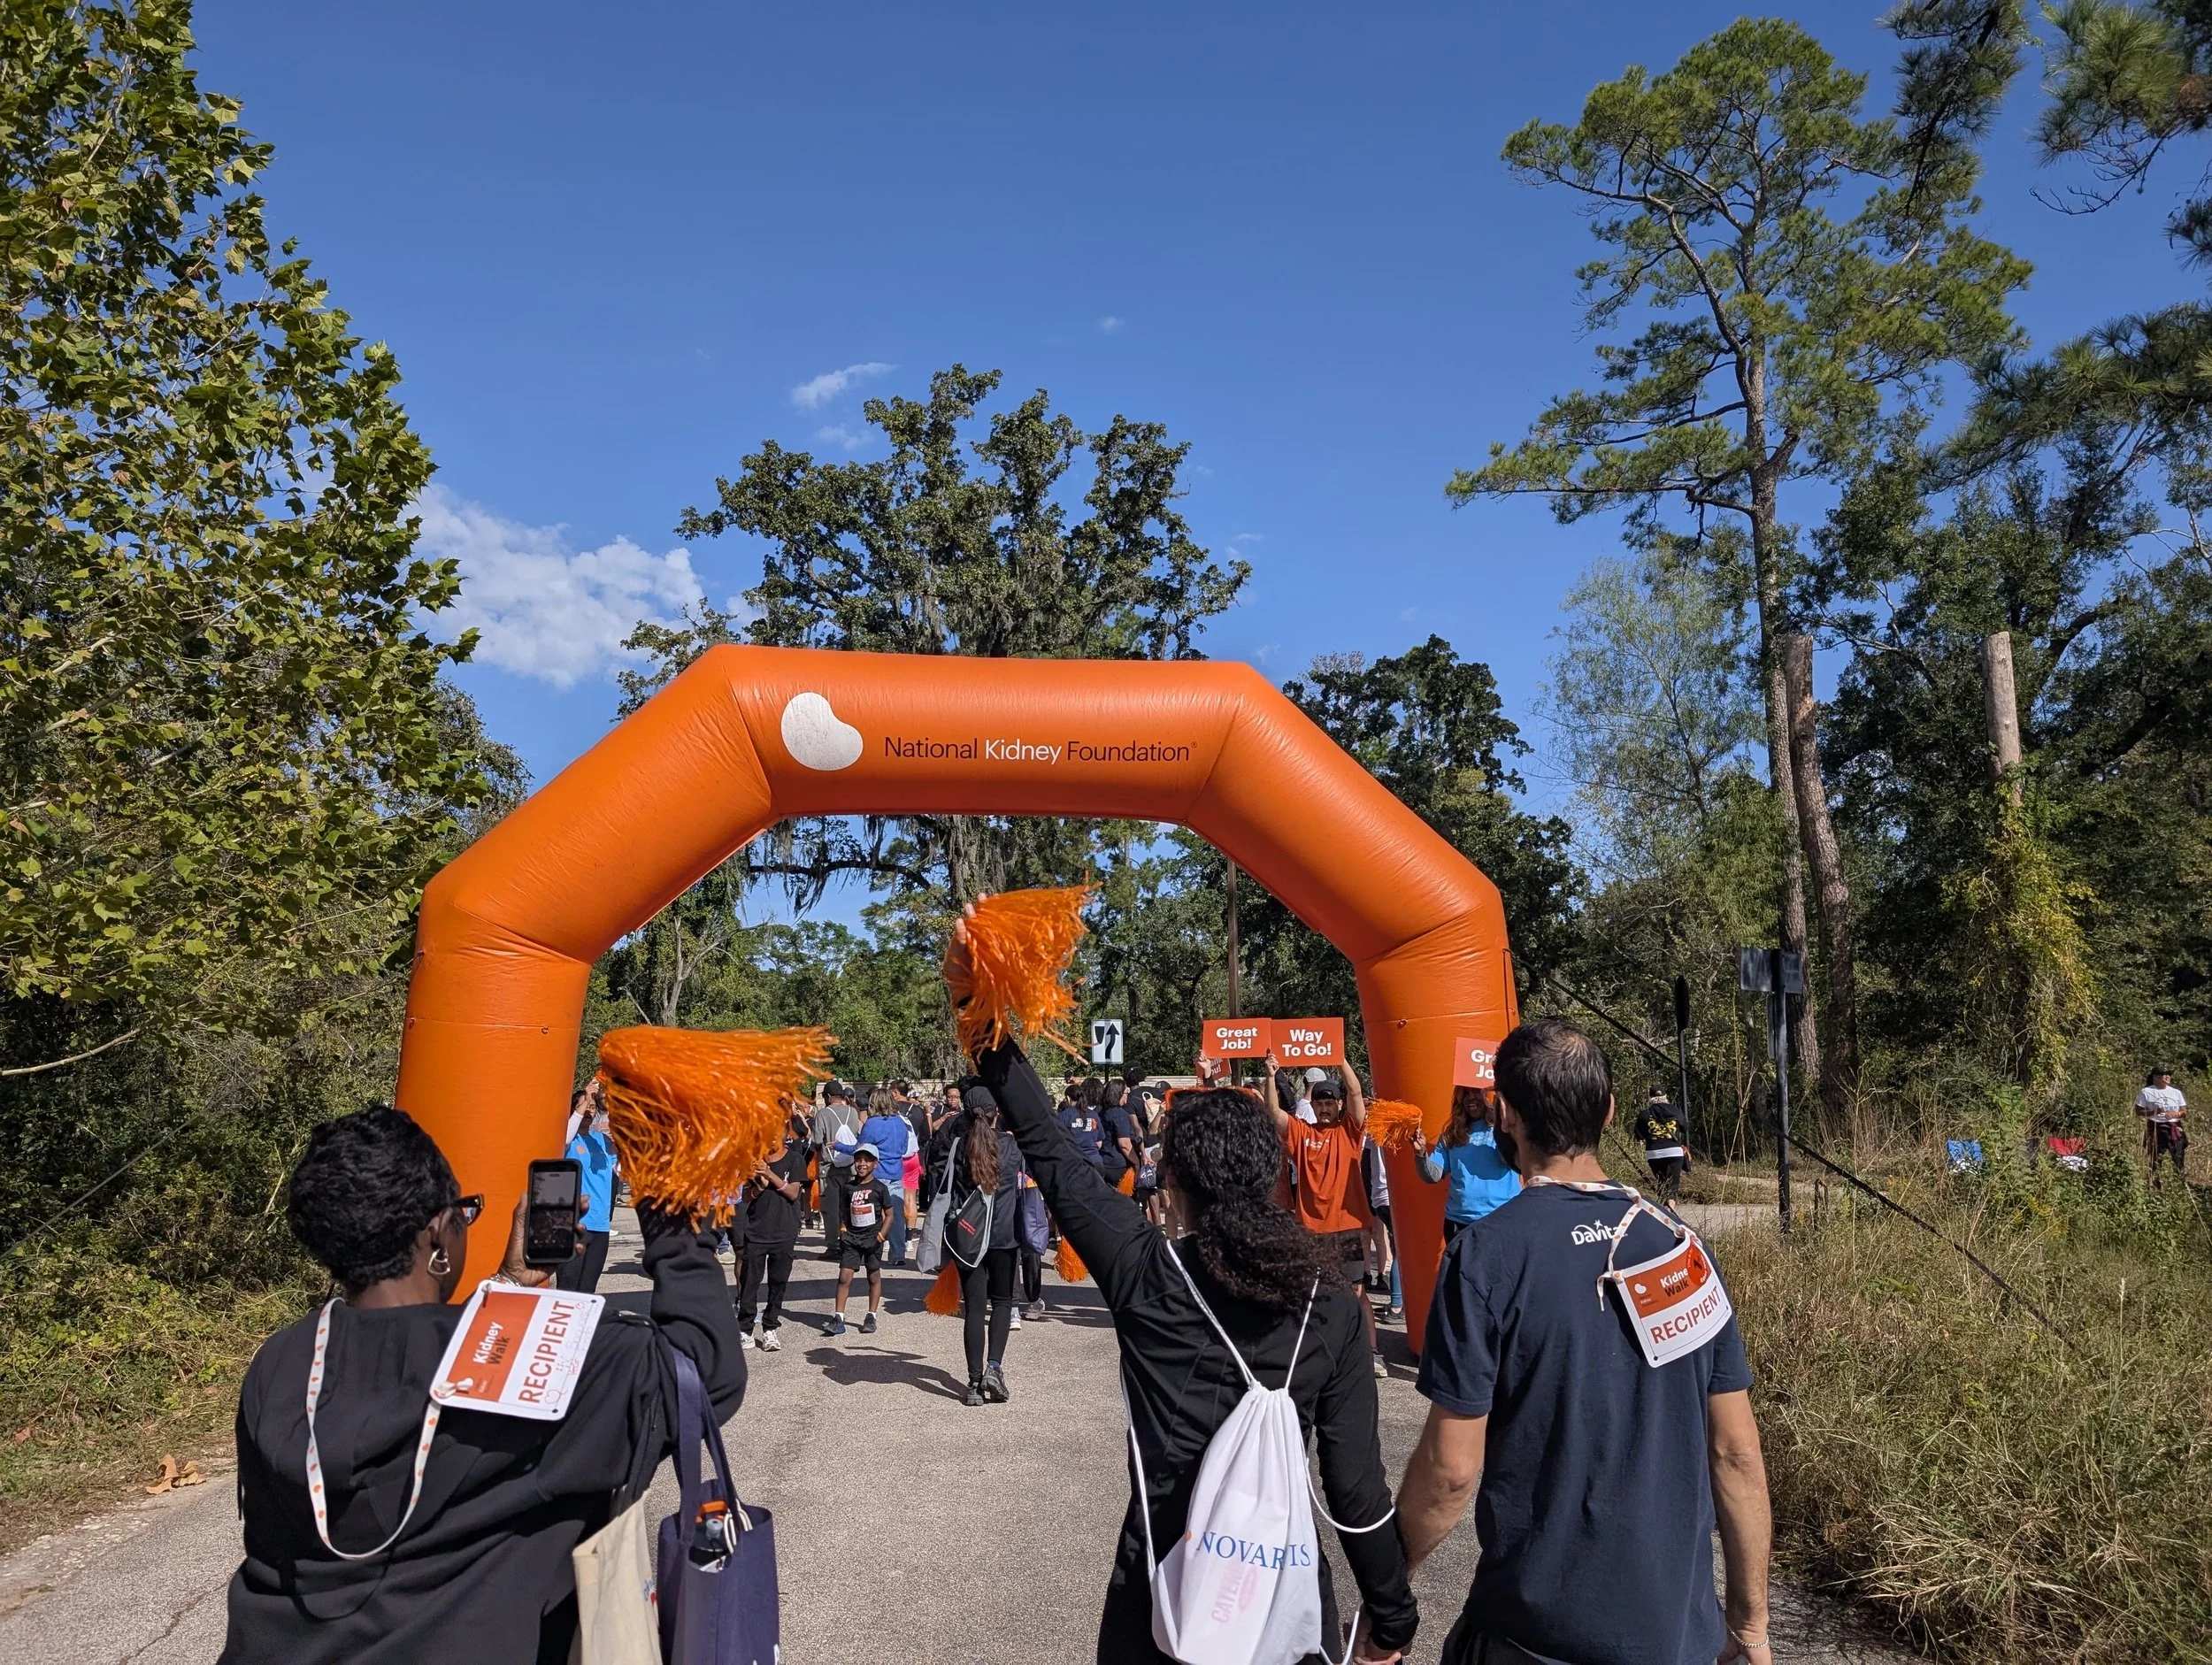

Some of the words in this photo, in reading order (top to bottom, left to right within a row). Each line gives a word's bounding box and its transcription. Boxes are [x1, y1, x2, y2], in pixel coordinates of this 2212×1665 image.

[885, 736, 977, 759] National
[985, 738, 1062, 765] Kidney
[1216, 1026, 1258, 1039] Great
[1289, 1029, 1324, 1044] Way
[1220, 1038, 1252, 1050] Job!
[1282, 1044, 1302, 1057] To
[1303, 1042, 1332, 1056] Go!
[1660, 1267, 1688, 1288] Kidne
[1664, 1279, 1690, 1298] Walk
[1649, 1285, 1722, 1345] RECIPIENT
[472, 1321, 503, 1364] Kidney
[488, 1336, 511, 1366] Walk
[518, 1301, 575, 1404] RECIPIENT
